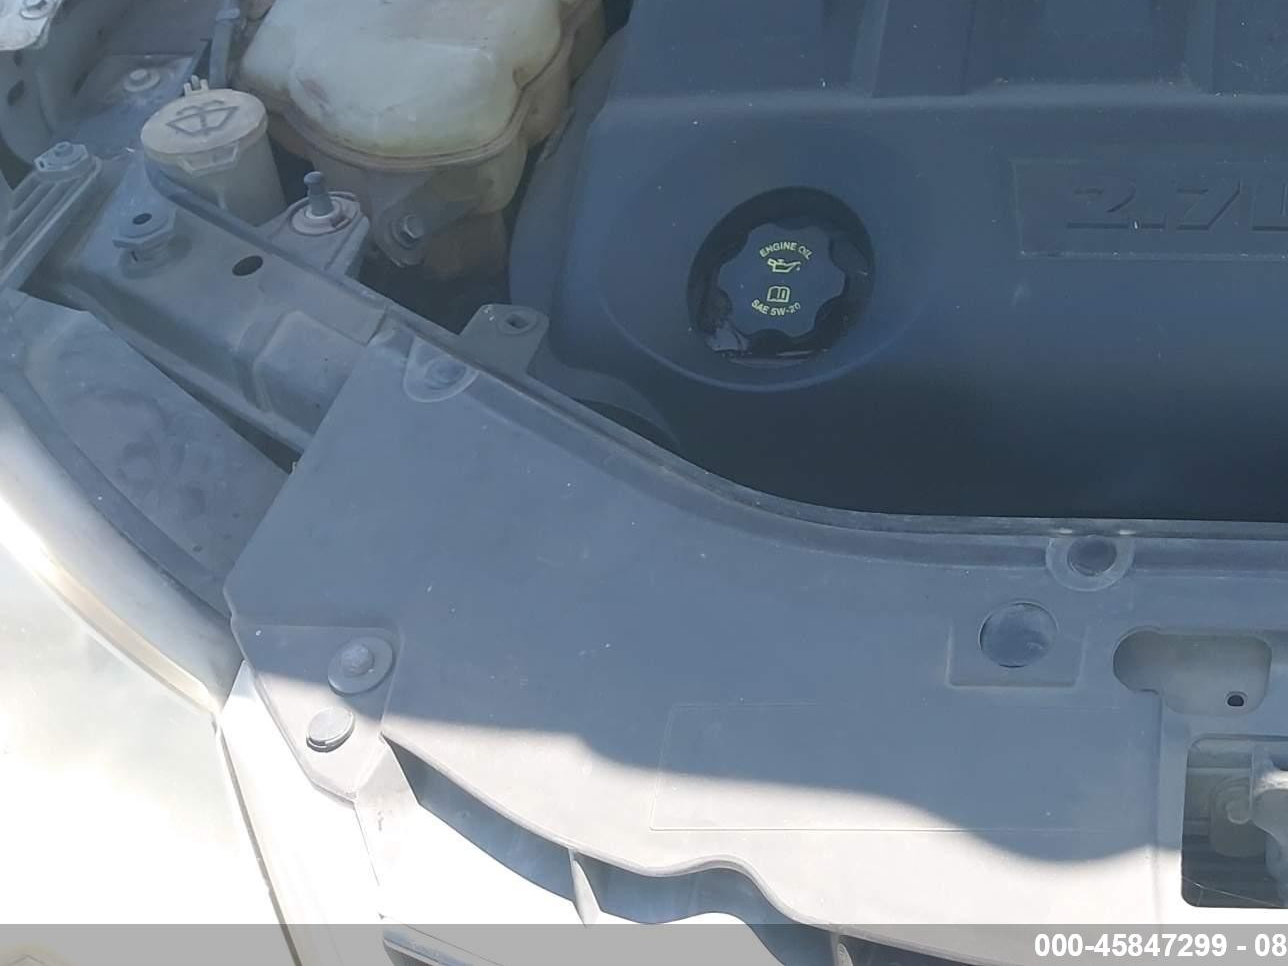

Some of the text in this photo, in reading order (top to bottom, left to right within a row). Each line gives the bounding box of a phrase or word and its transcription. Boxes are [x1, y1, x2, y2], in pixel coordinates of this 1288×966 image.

[759, 241, 813, 260] ENGINE OIL
[751, 299, 801, 316] SAE 5W-20
